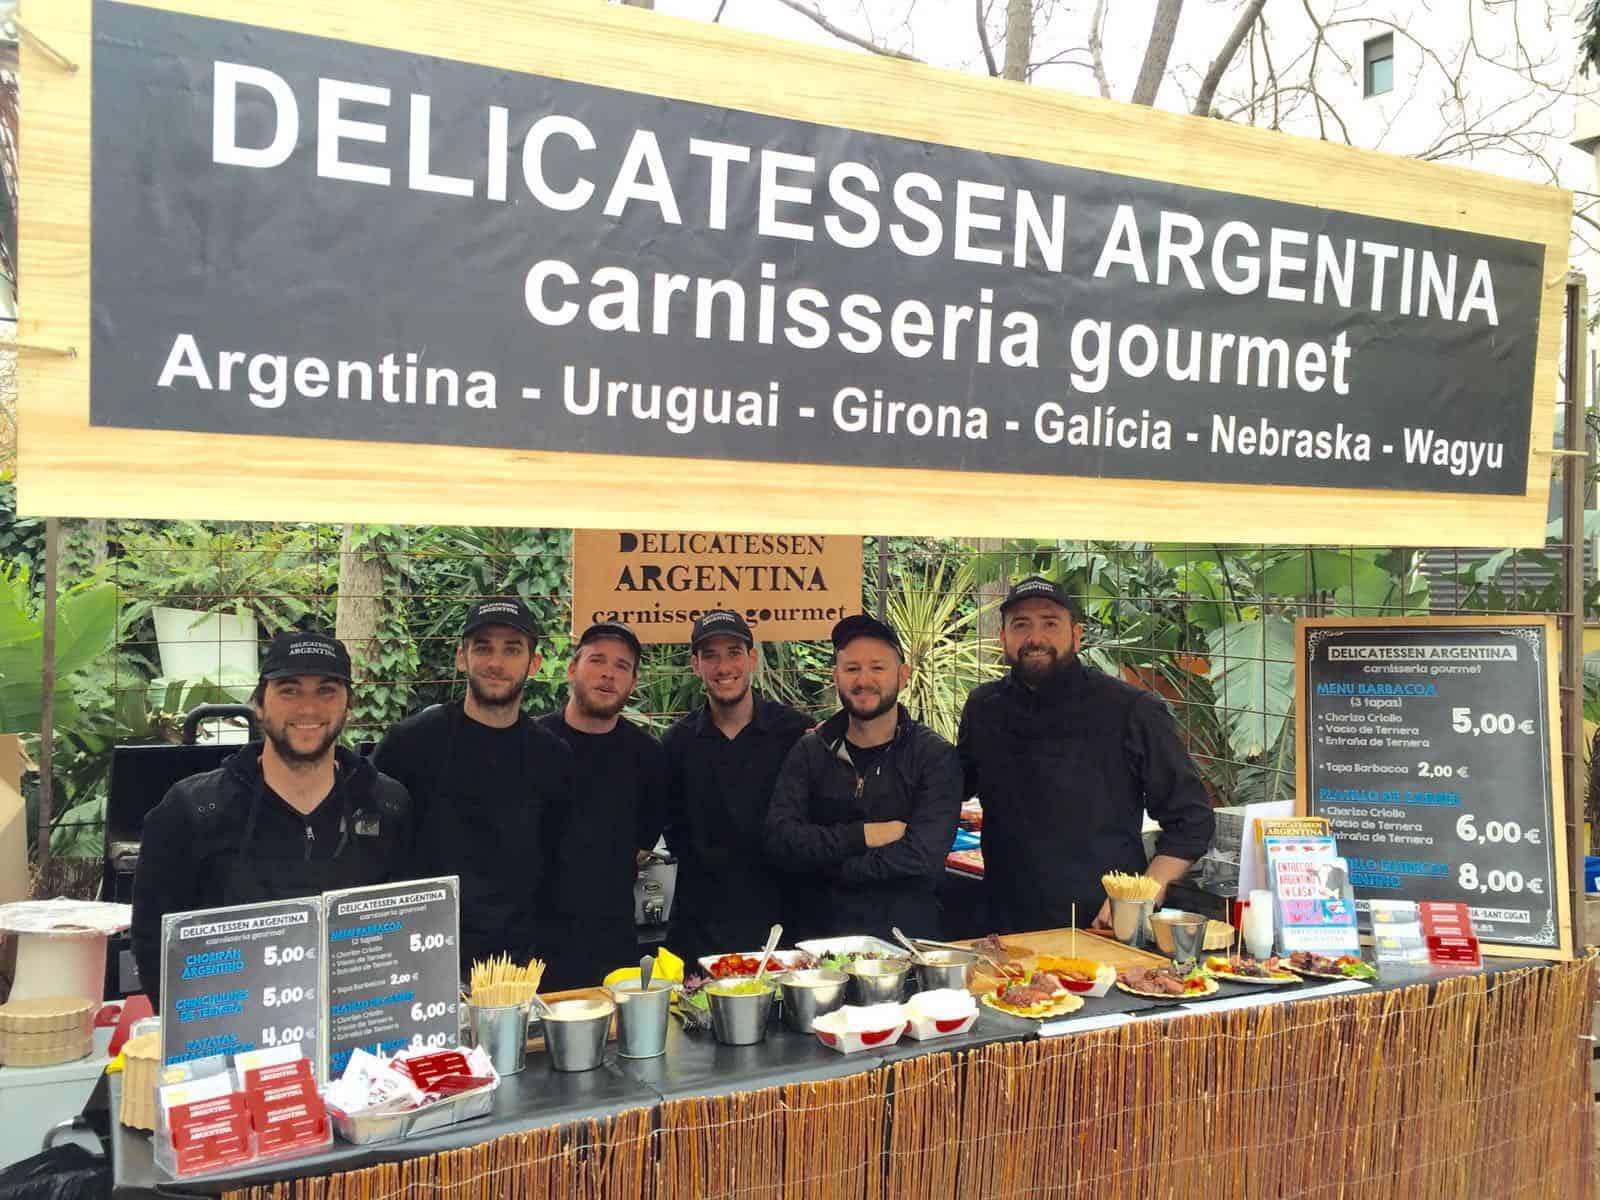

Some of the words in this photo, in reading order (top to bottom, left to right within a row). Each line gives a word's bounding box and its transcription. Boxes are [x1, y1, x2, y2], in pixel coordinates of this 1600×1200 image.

[213, 60, 1066, 272] DELICATESSEN
[1093, 205, 1498, 325] ARGENTINA
[525, 260, 1038, 368] carnisseria
[1071, 319, 1351, 394] gourmet
[157, 334, 496, 408] Argentina
[564, 366, 778, 433] Uruguai
[833, 387, 987, 439] Girona
[1035, 402, 1171, 450] Galícia
[1211, 415, 1370, 460] Nebraska
[1404, 428, 1503, 476] Wagyu
[619, 532, 825, 556] DELICATESSEN
[614, 565, 828, 592] ARGENTINA
[592, 602, 737, 624] carnisse
[746, 604, 846, 627] gourmet
[1331, 647, 1425, 659] DELICATESSEN
[1430, 647, 1513, 659] ARGENTINA
[1363, 663, 1427, 673] carnisseria
[1430, 664, 1482, 675] gourmet
[1317, 683, 1354, 695] MENU
[1359, 683, 1437, 696] BARBACOA
[1325, 712, 1365, 722] Chorizo
[1367, 713, 1403, 723] Criollo
[1359, 725, 1373, 734] de
[1375, 726, 1419, 736] Ternera
[1325, 736, 1367, 746] Entraña
[1369, 737, 1383, 747] de
[1386, 738, 1430, 748] Ternera
[1326, 761, 1352, 774] Tapa
[1354, 763, 1408, 774] Barbacoa
[1418, 761, 1453, 779] 2,00
[1327, 806, 1368, 817] Chorizo
[1361, 820, 1376, 829] de
[1379, 821, 1422, 832] Ternera
[1333, 830, 1369, 841] ntraña
[1372, 832, 1386, 842] de
[1389, 833, 1433, 845] Ternera
[340, 899, 397, 914] DELICATESSEN
[399, 892, 444, 905] ARGENTINA
[183, 920, 249, 938] DELICATESSEN
[252, 913, 306, 929] ARGENTINA
